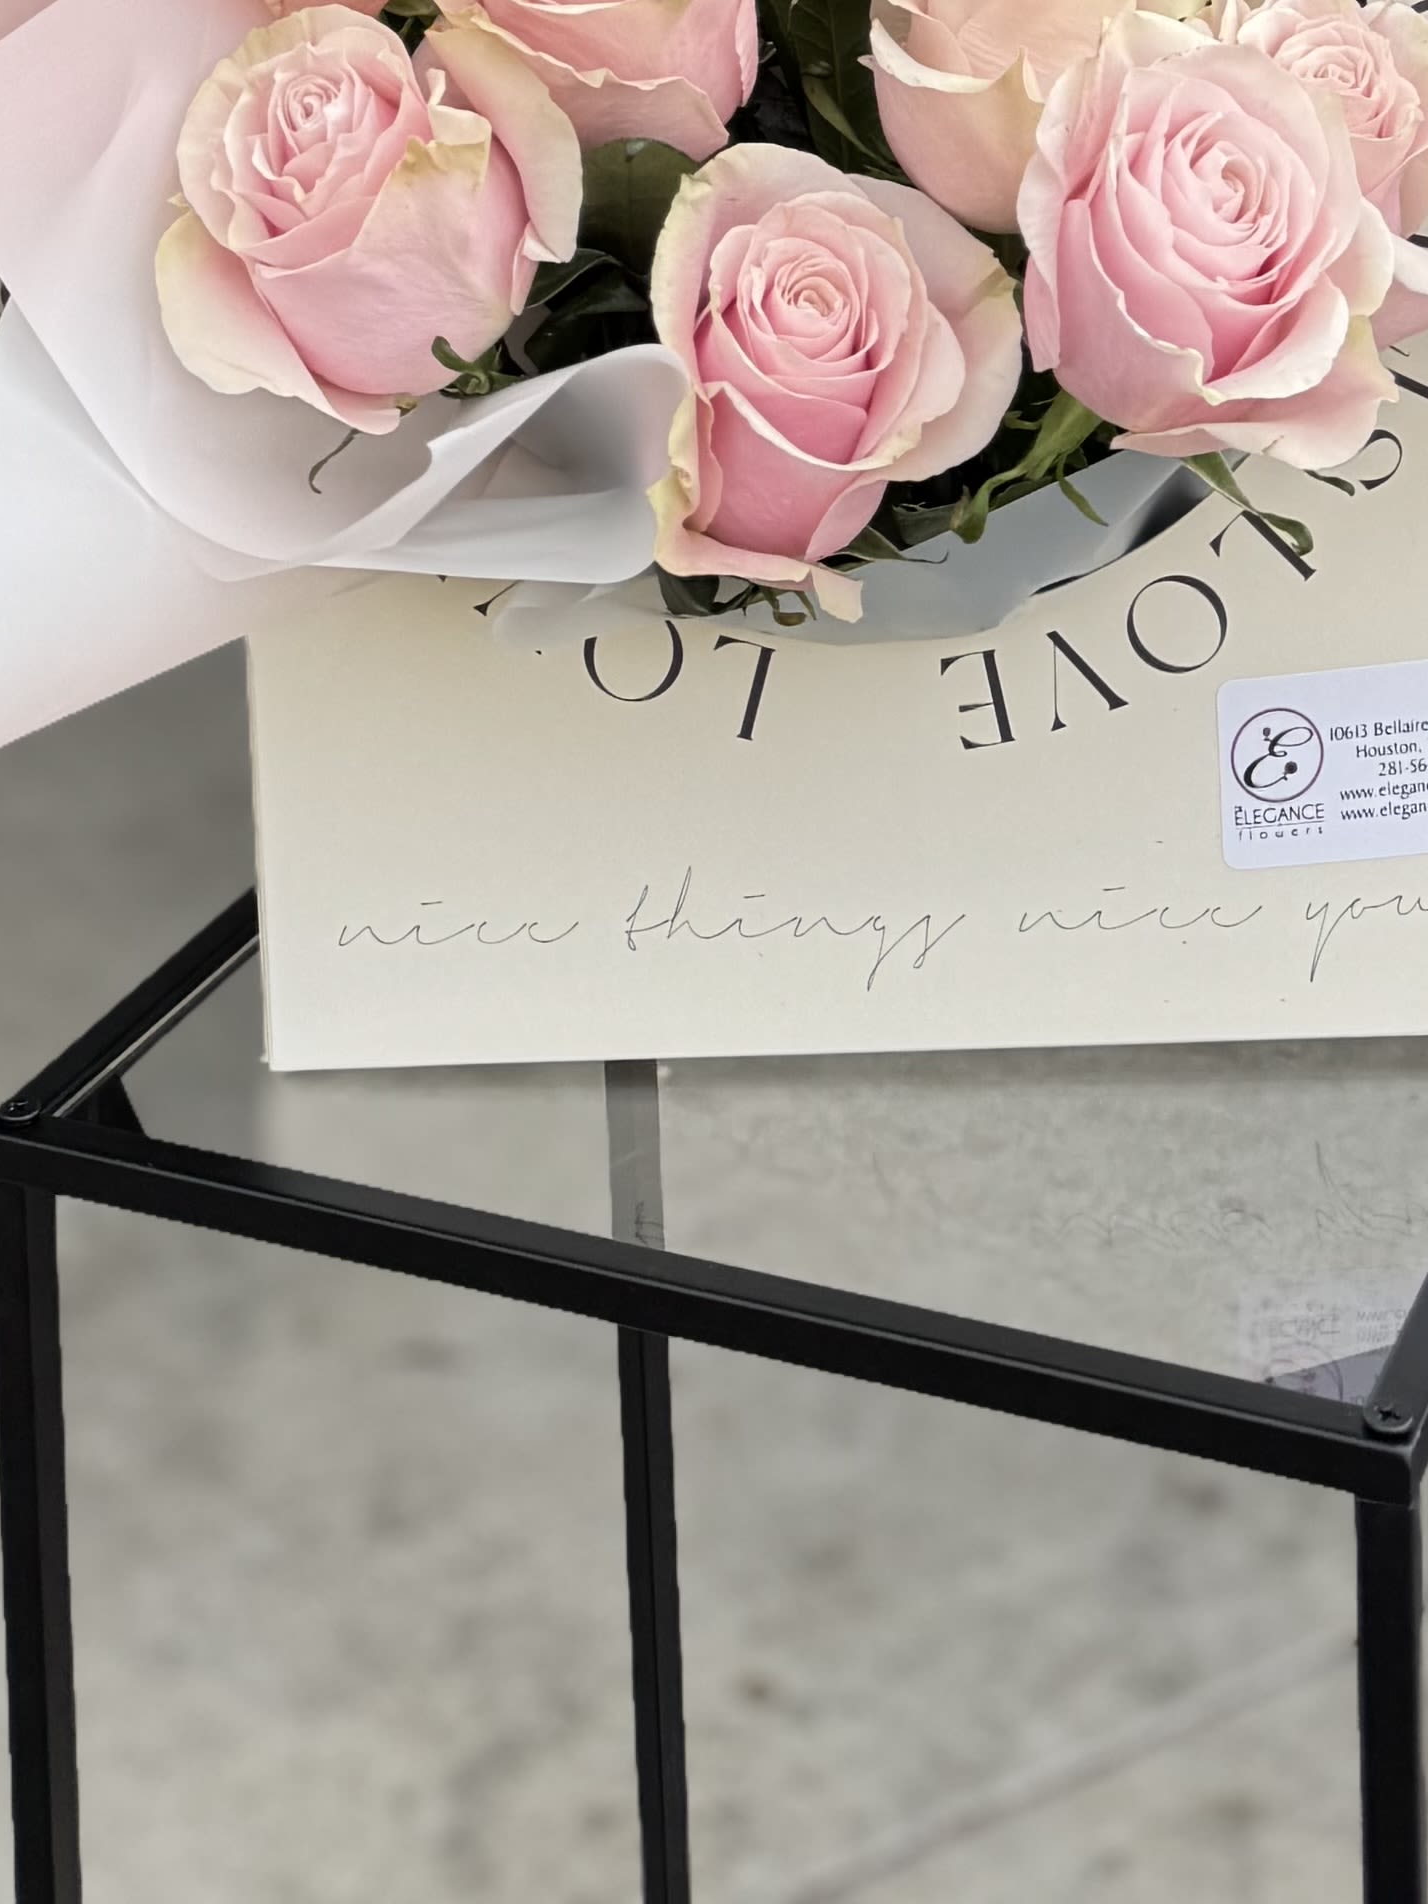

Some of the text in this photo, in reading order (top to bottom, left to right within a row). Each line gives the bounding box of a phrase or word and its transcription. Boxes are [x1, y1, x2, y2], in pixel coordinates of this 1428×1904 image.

[939, 508, 1317, 751] LOVE
[1330, 723, 1368, 741] 10613
[1374, 717, 1428, 737] Bellaire
[1233, 802, 1325, 827] ELEGANCE
[1238, 826, 1324, 842] flowers
[622, 865, 967, 990] things
